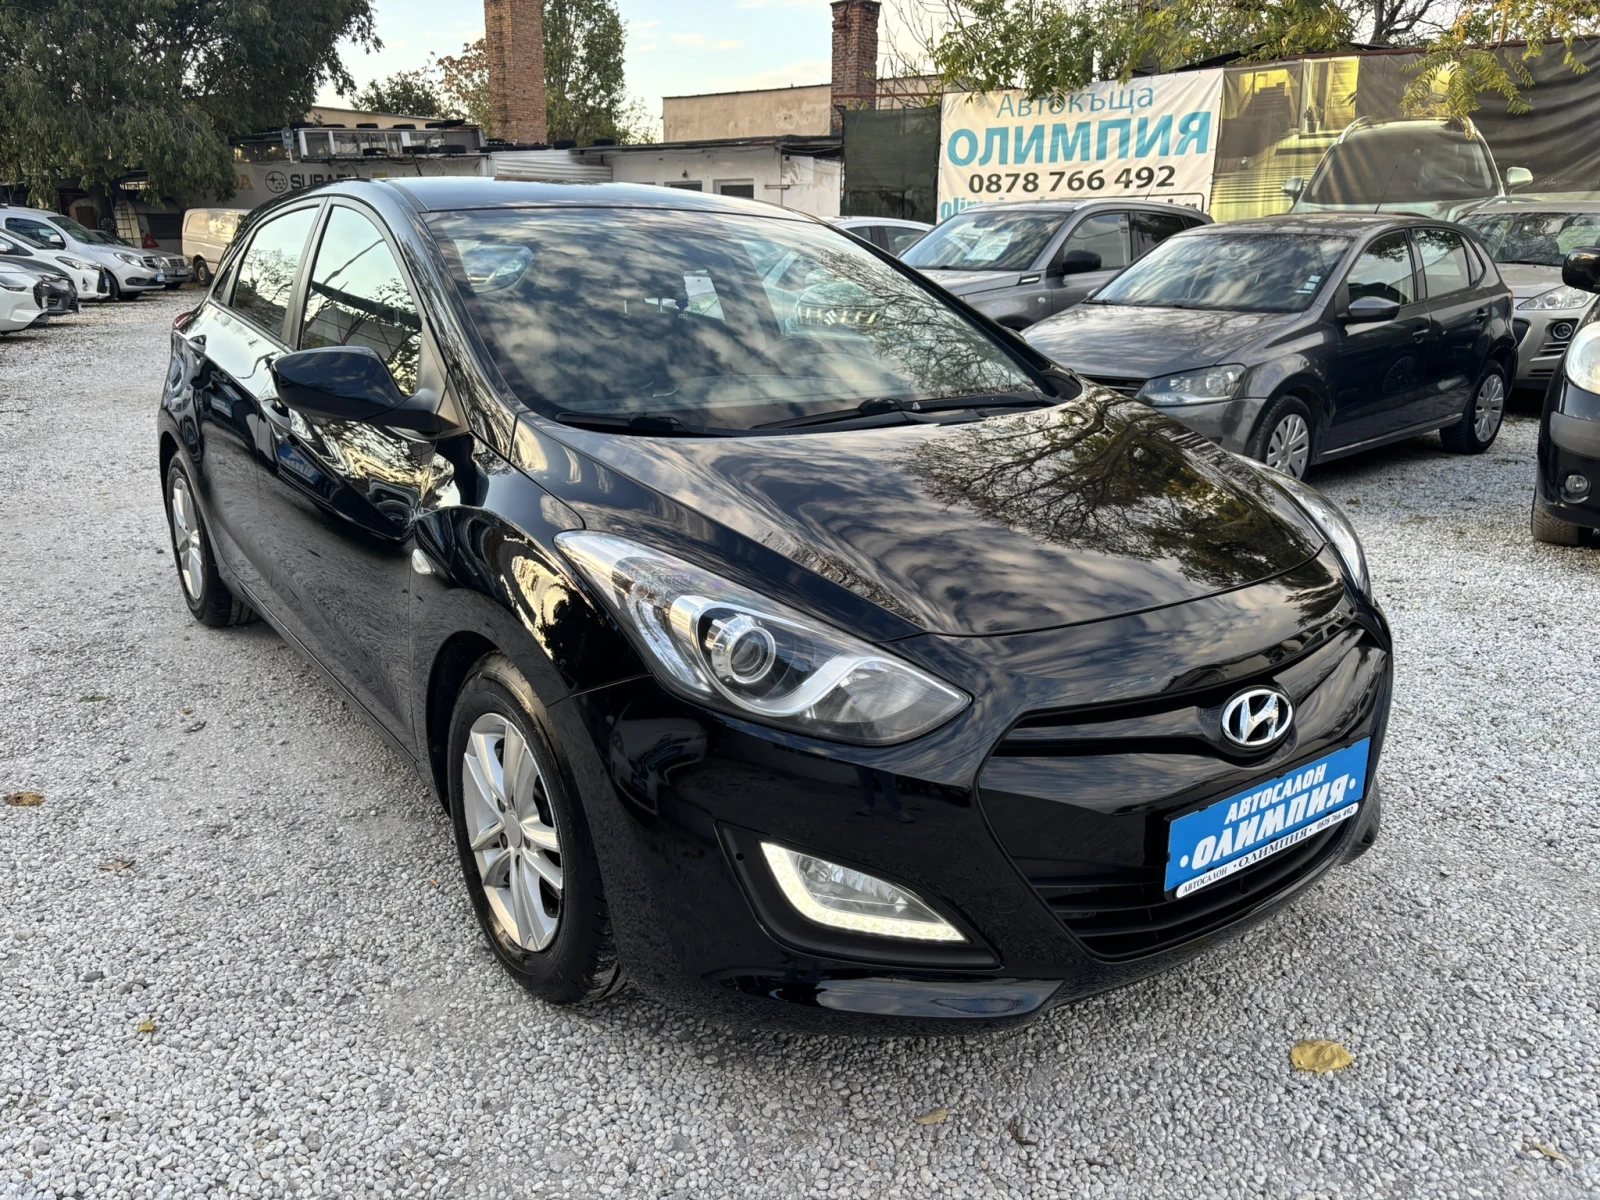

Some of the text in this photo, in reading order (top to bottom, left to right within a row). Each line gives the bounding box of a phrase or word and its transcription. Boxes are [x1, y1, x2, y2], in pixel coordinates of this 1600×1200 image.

[997, 87, 1154, 118] Автокъща
[948, 112, 1211, 166] ОЛИМПИЯ
[969, 166, 1175, 193] 0878 766 492
[1224, 763, 1327, 825] АВТОСАЛОН
[1183, 867, 1227, 893] АВТОСАЛОН
